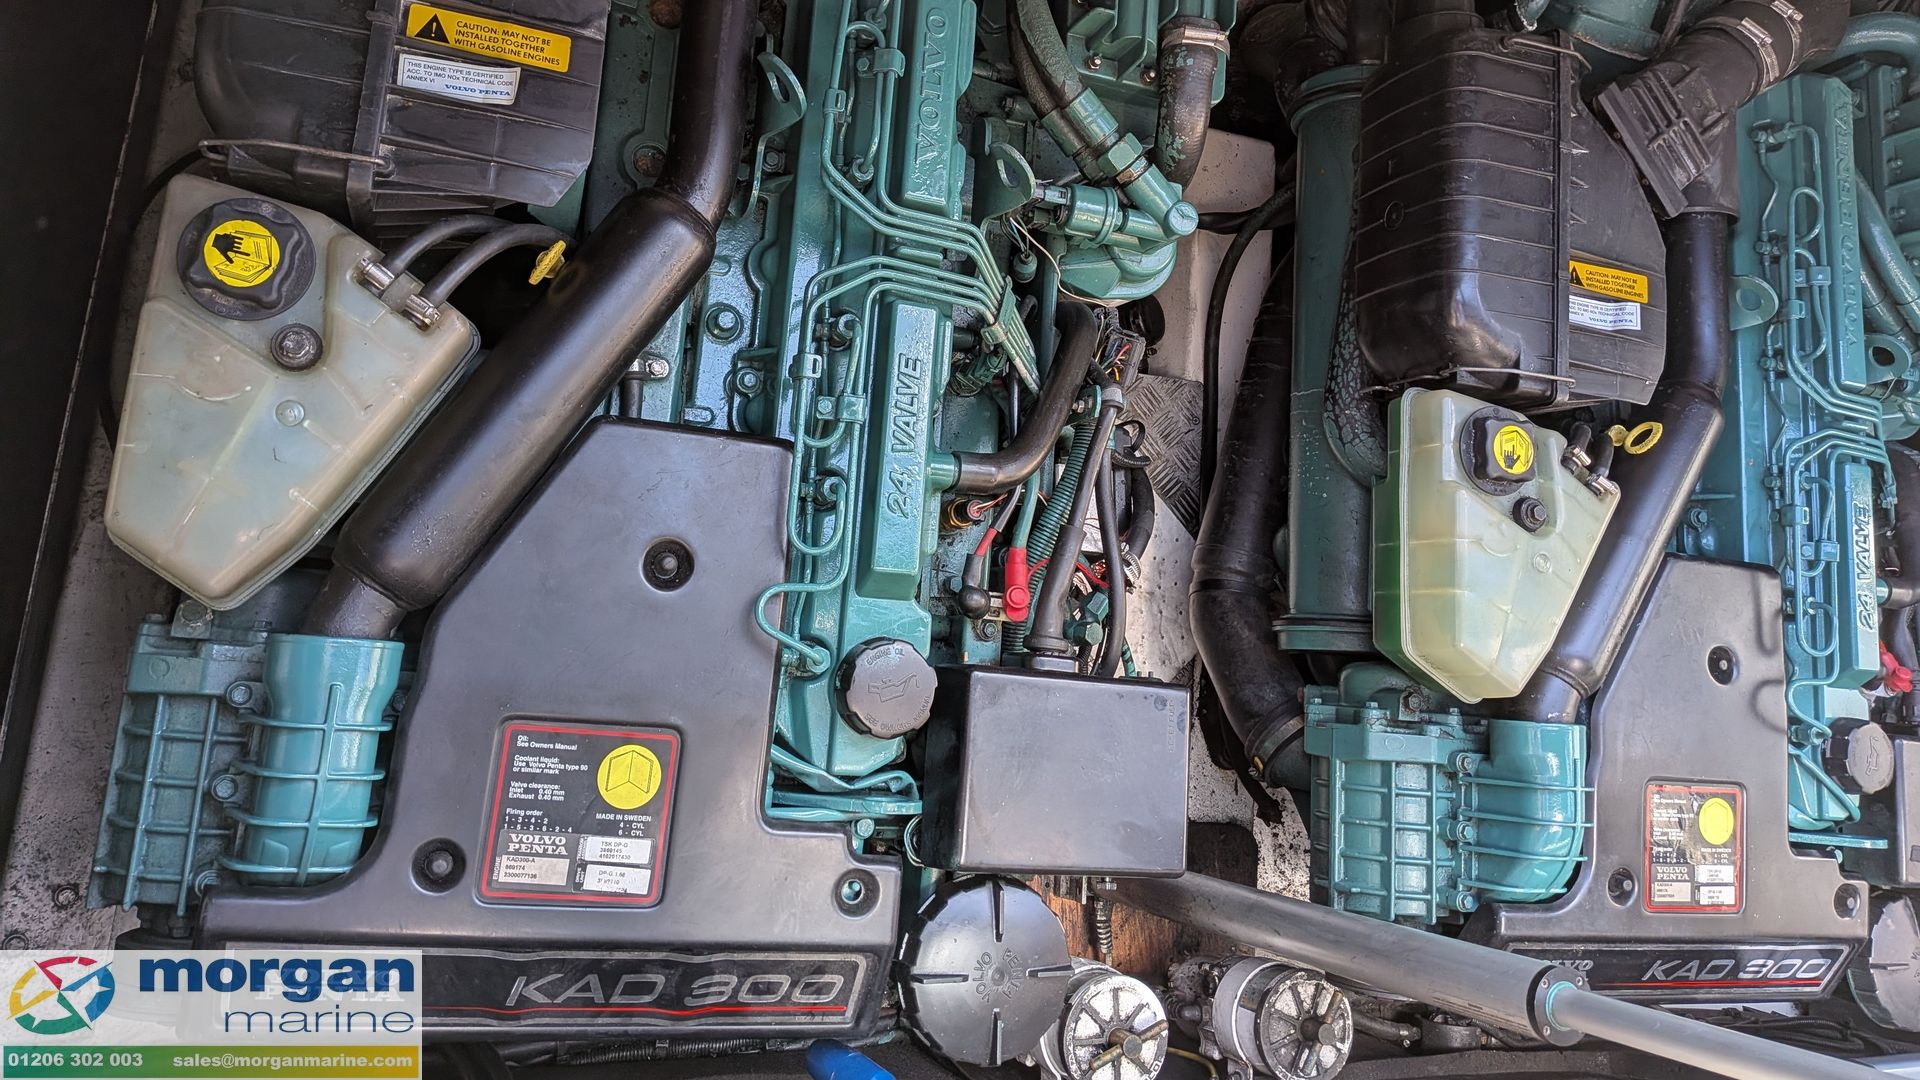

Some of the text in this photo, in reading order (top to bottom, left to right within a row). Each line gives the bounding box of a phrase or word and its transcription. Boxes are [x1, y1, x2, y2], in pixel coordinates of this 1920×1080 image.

[455, 29, 545, 53] INSTALLED TOGETHER
[456, 21, 500, 36] CAUTION:
[502, 30, 520, 39] MAY
[522, 34, 540, 44] NOT
[454, 38, 560, 66] WITH GASOLINE ENGINES
[406, 75, 429, 83] ANNEX
[423, 63, 447, 72] ENGINE
[448, 67, 464, 75] TYPE
[472, 70, 504, 80] CERTIFIED
[462, 76, 495, 86] TECHNICAL
[444, 84, 477, 93] VOLVO
[914, 8, 948, 164] VOLVO
[887, 352, 922, 520] 24 VALVE
[1852, 502, 1874, 631] 24 VALVE
[514, 754, 539, 763] Coolant
[506, 808, 526, 817] Firing
[509, 833, 567, 844] VOLVO
[507, 843, 568, 855] PENTA
[1641, 958, 1832, 982] KAD 300
[505, 974, 845, 1006] KAD 300
